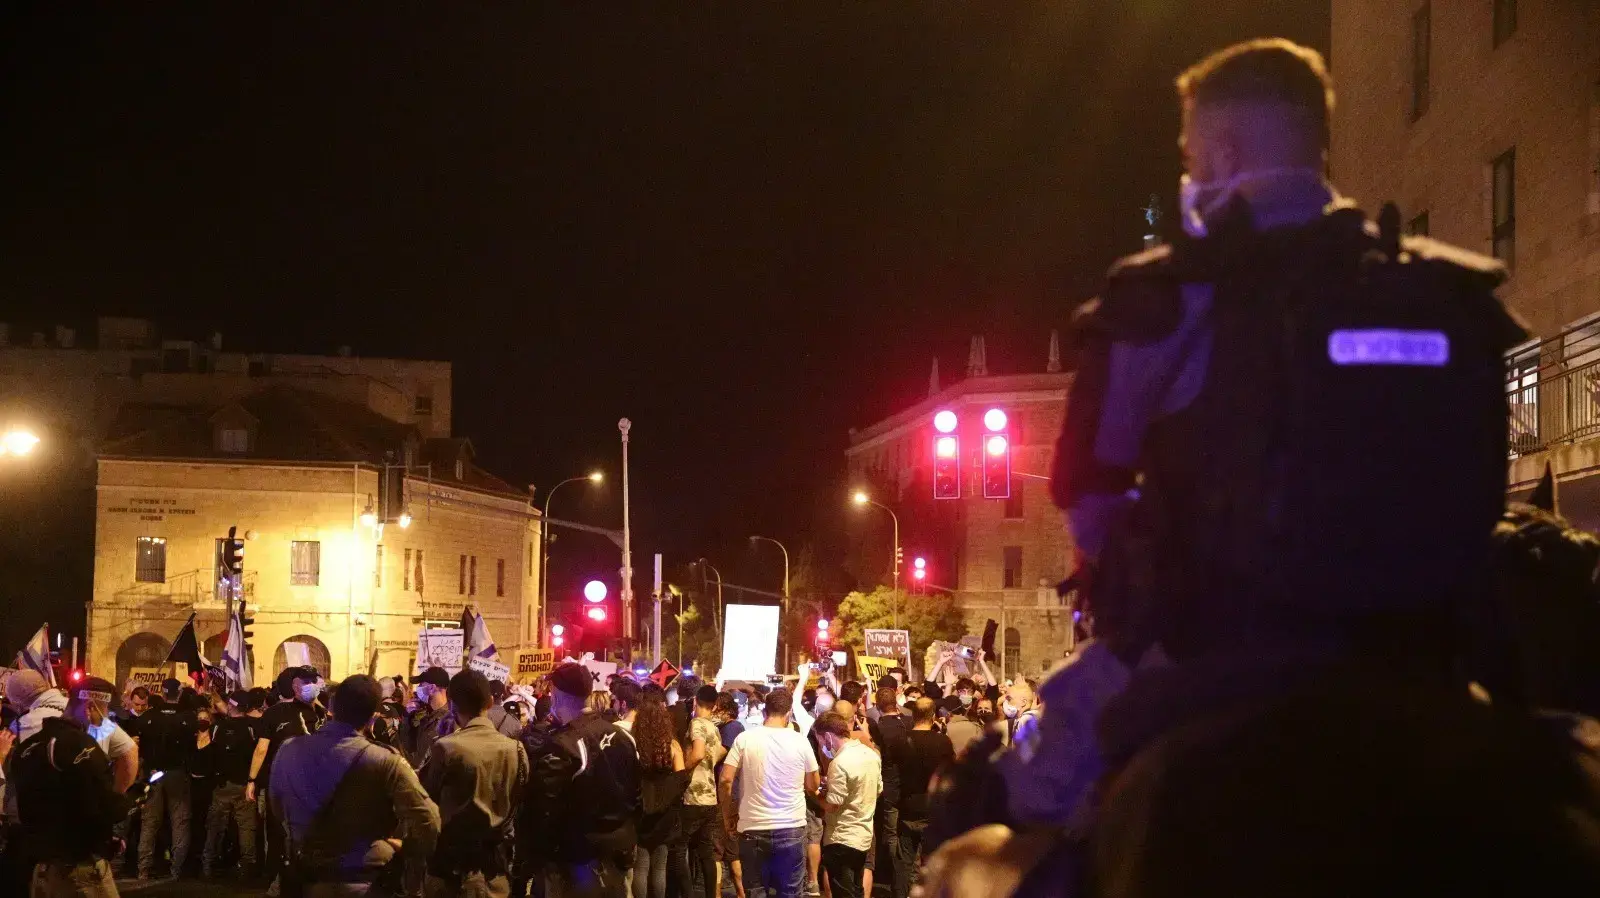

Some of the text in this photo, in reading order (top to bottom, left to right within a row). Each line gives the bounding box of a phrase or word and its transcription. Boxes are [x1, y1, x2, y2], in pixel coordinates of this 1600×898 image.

[867, 632, 905, 645] לא אשתוק
[873, 646, 893, 655] ארצי
[897, 646, 907, 655] כי
[519, 653, 552, 664] מנותקים
[518, 663, 551, 673] נמאסתם
